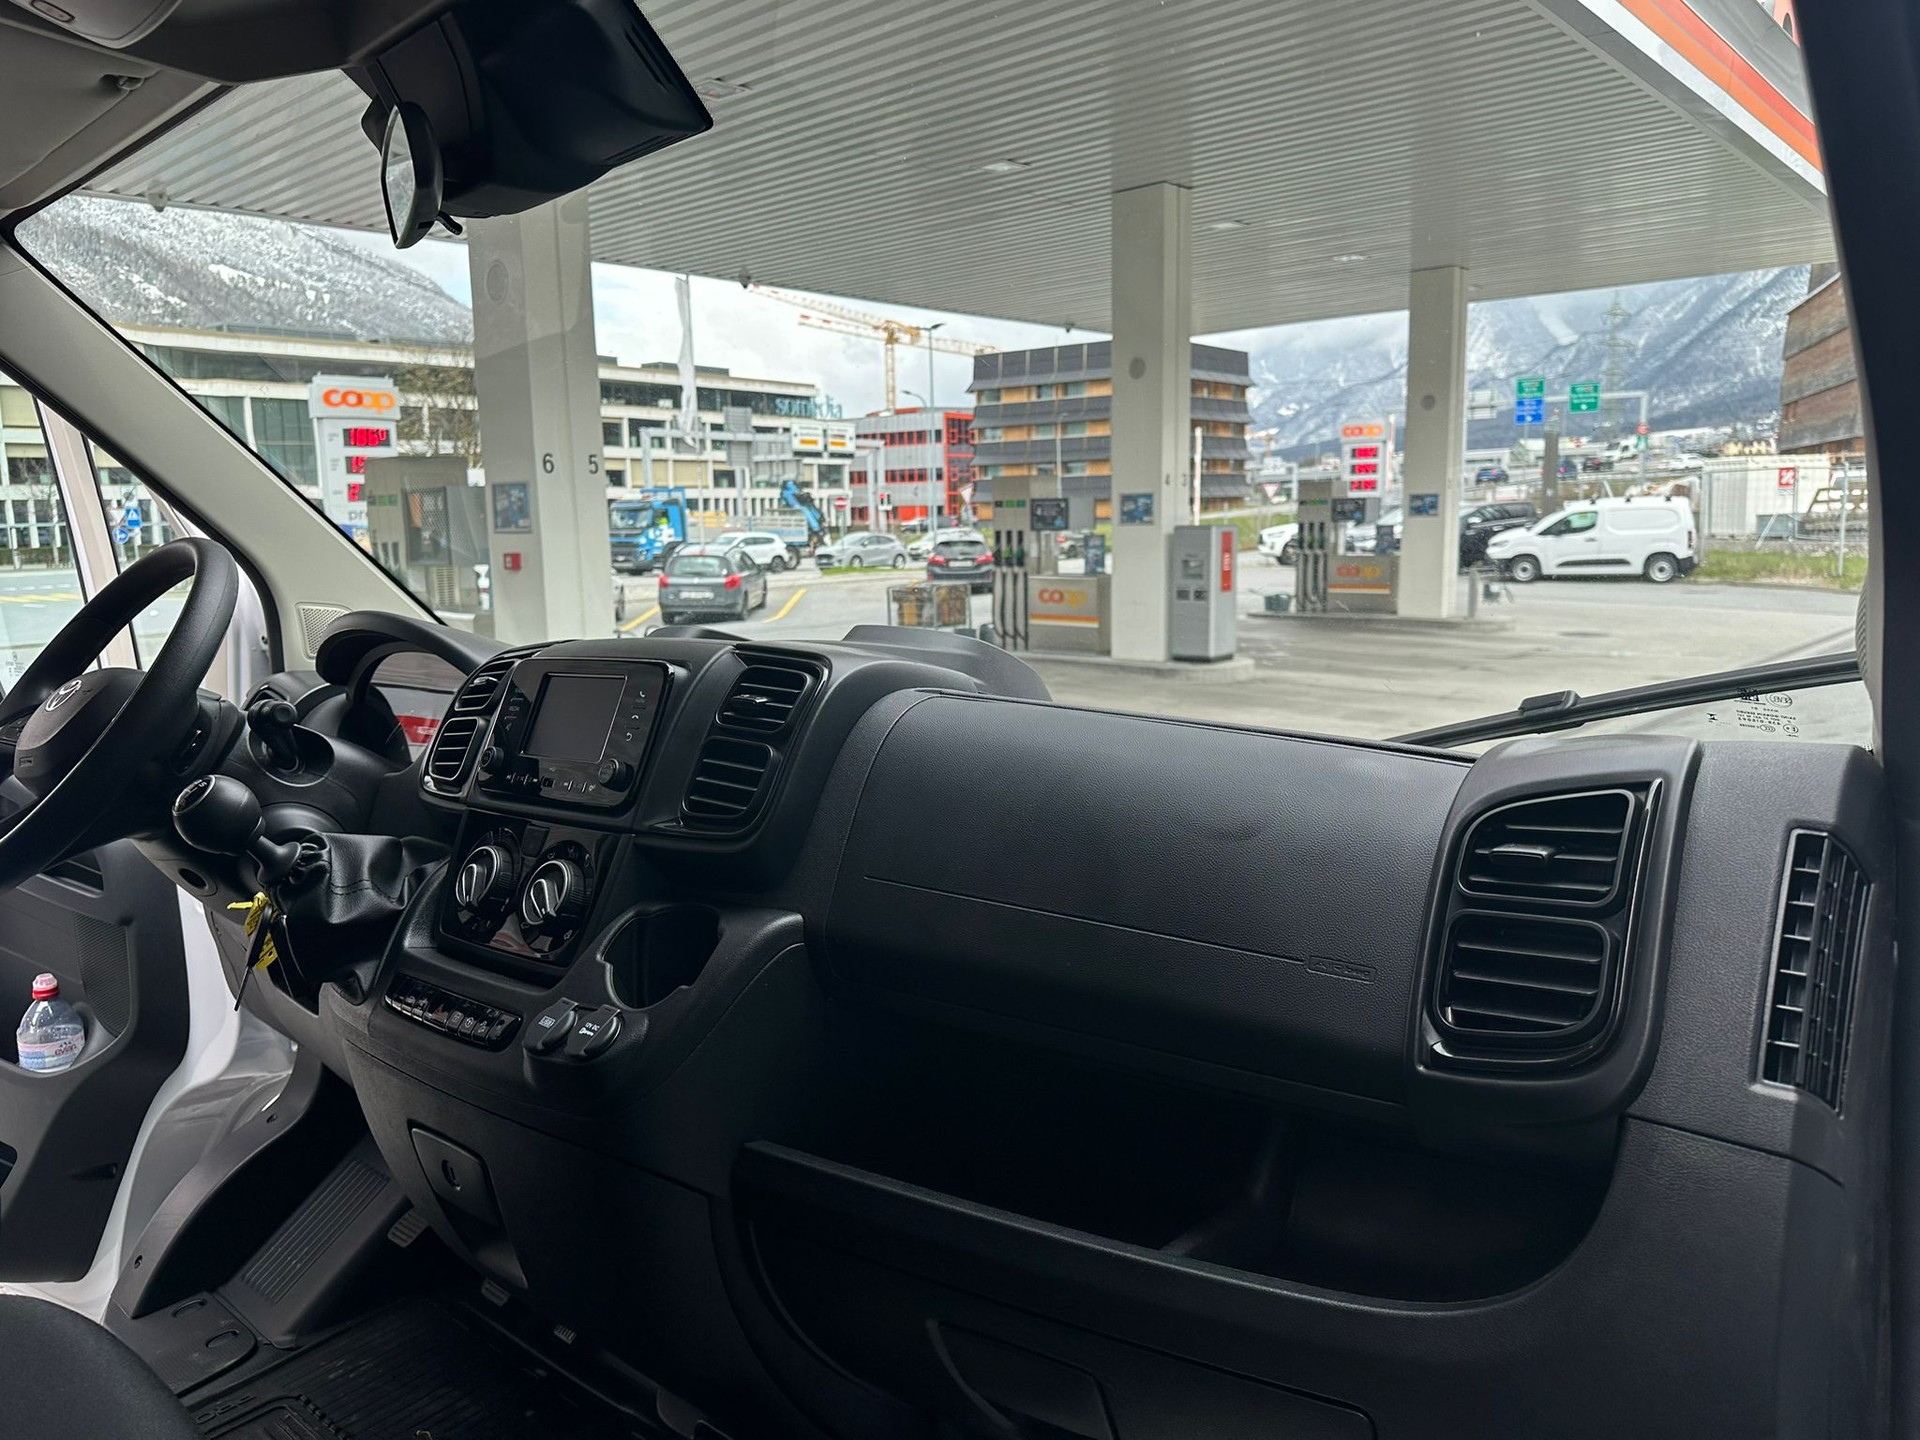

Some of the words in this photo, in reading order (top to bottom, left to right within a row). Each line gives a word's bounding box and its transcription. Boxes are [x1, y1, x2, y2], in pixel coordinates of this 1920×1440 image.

[323, 388, 395, 414] coop
[543, 453, 555, 474] 6
[588, 454, 599, 475] 5
